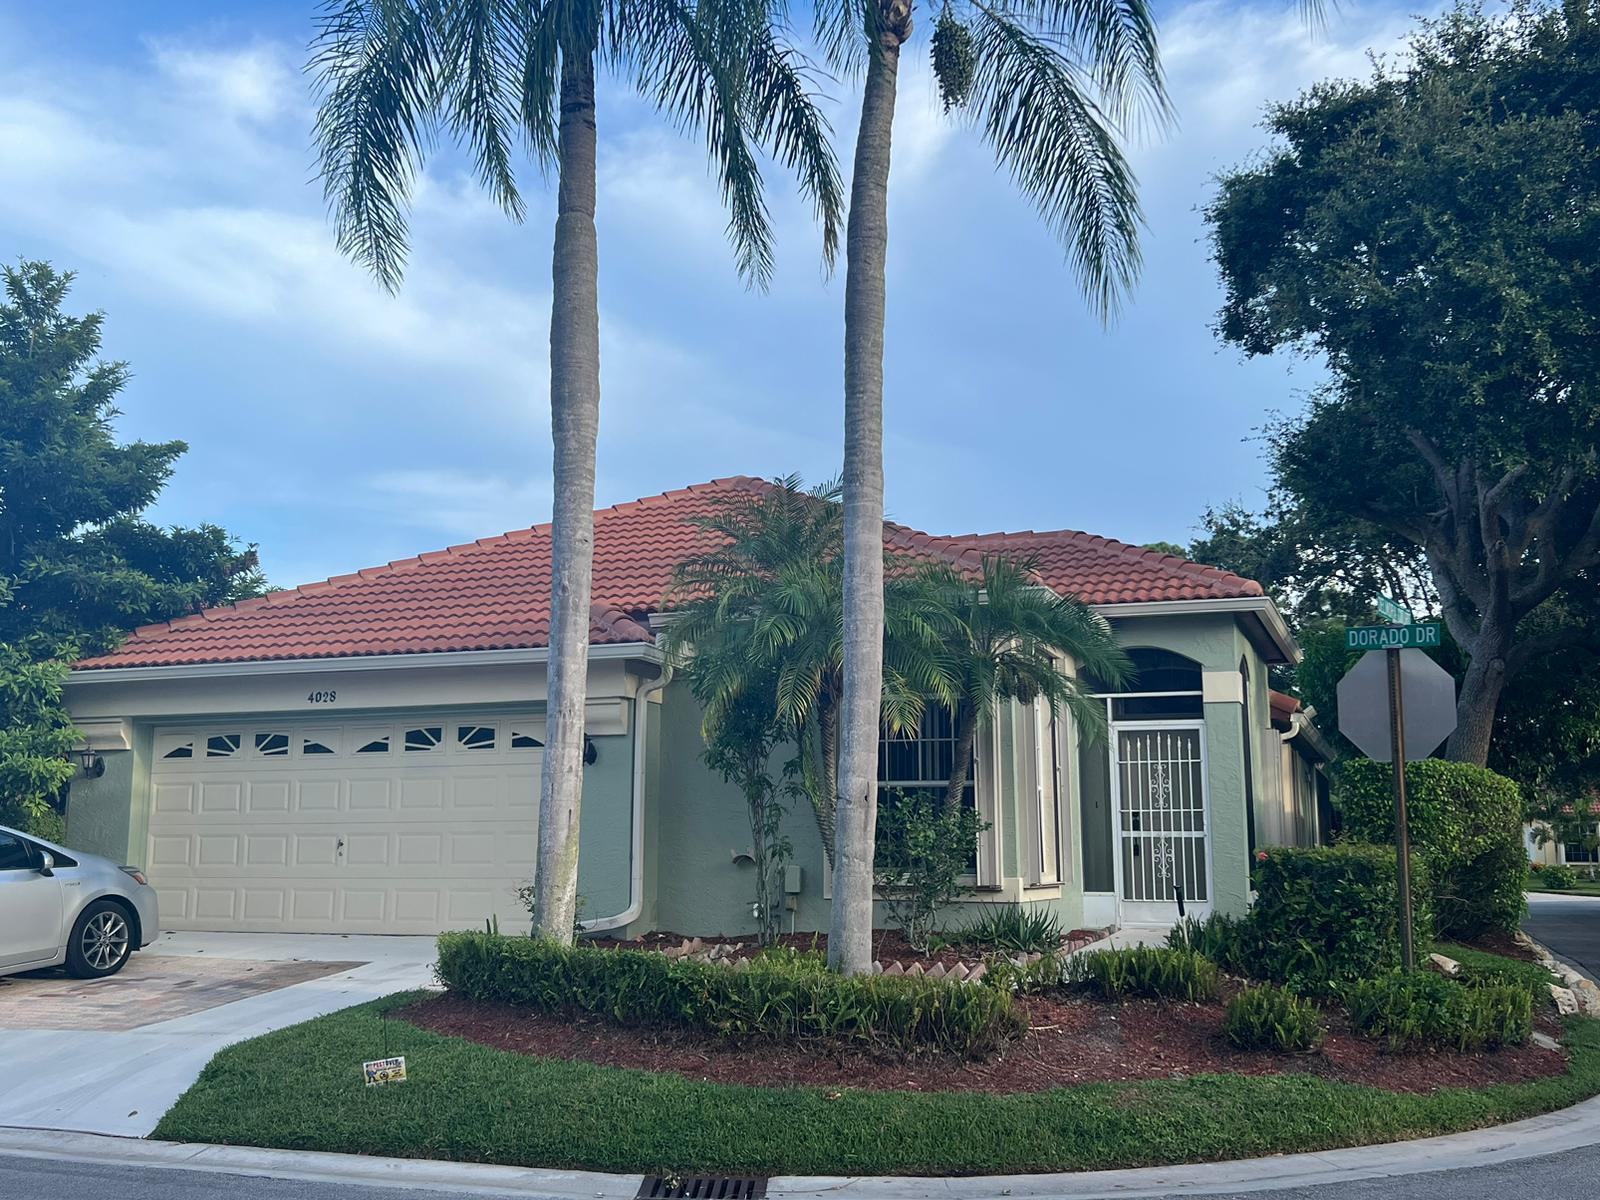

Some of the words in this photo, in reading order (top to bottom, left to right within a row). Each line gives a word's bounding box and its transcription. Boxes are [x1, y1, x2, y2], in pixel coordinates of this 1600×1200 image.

[1349, 629, 1409, 646] DORADO
[1416, 627, 1436, 643] DR
[307, 690, 337, 704] 4028
